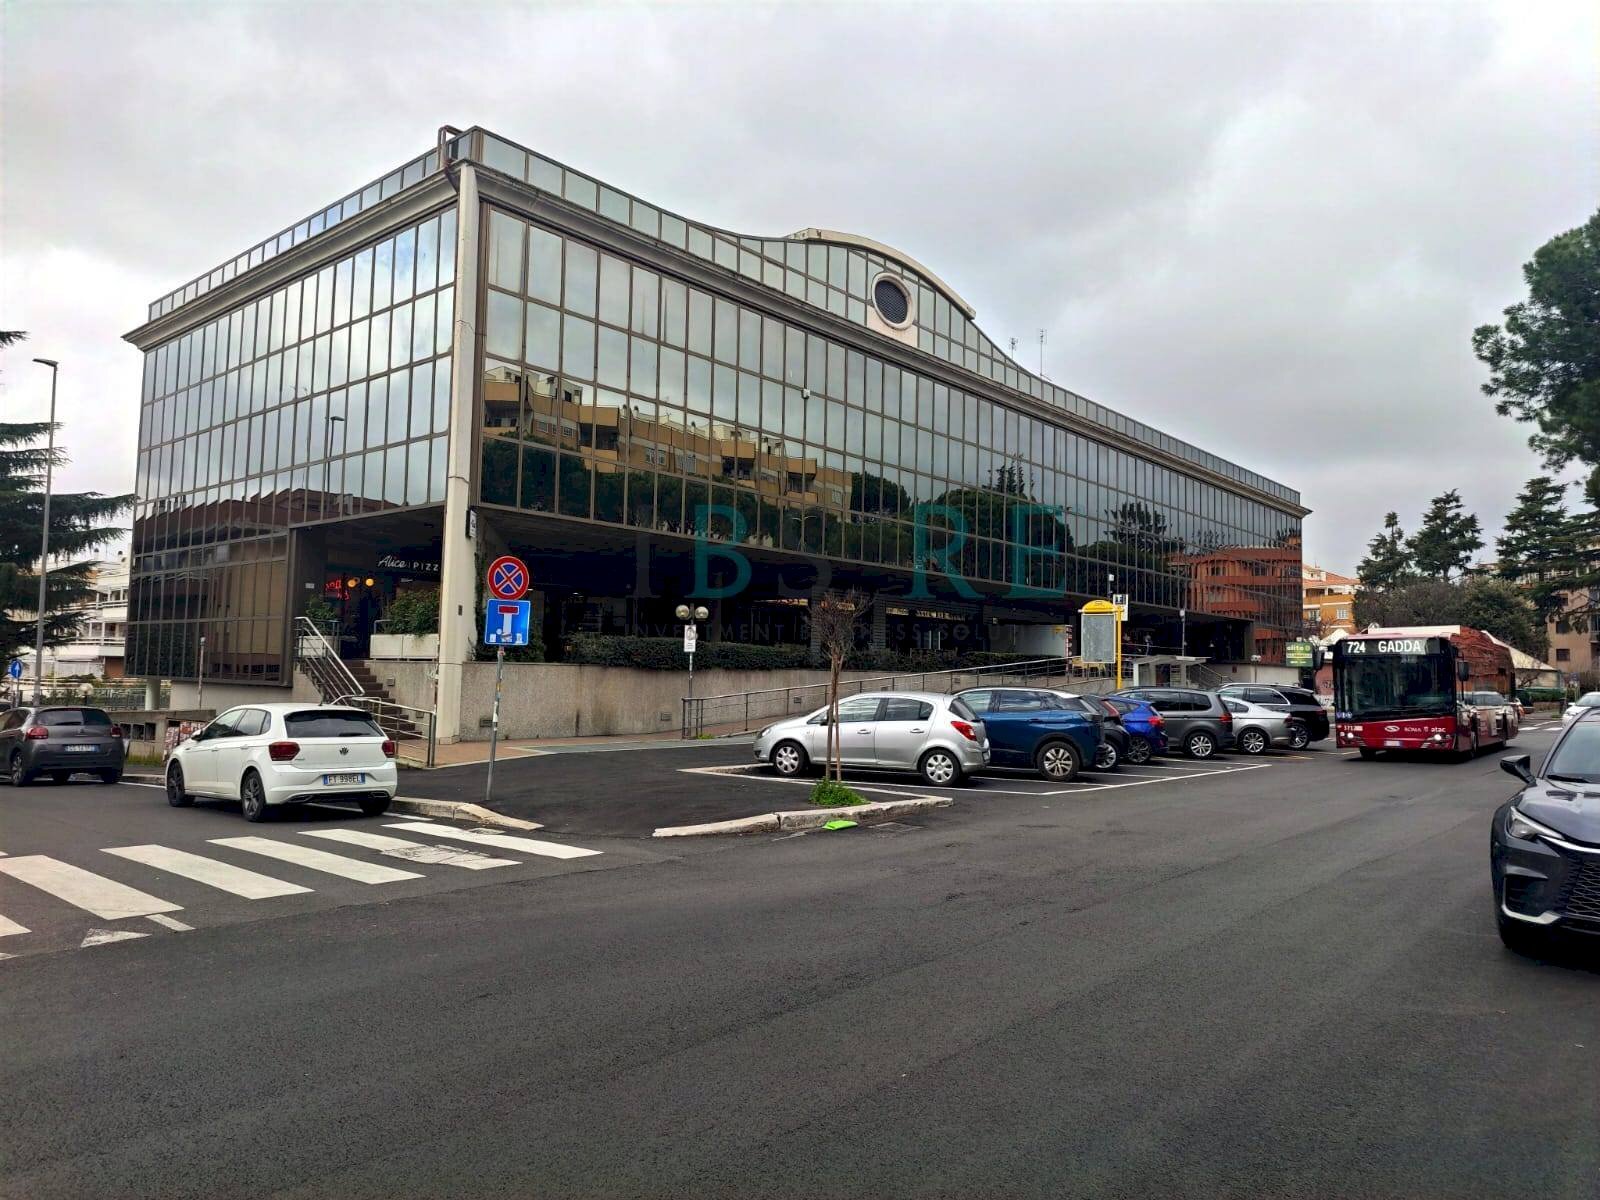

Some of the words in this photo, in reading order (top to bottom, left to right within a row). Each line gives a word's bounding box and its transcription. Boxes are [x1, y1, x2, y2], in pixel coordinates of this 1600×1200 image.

[378, 555, 406, 568] Alice
[413, 561, 439, 572] PIZZ
[1347, 641, 1366, 654] 724
[1378, 640, 1421, 653] GADDA
